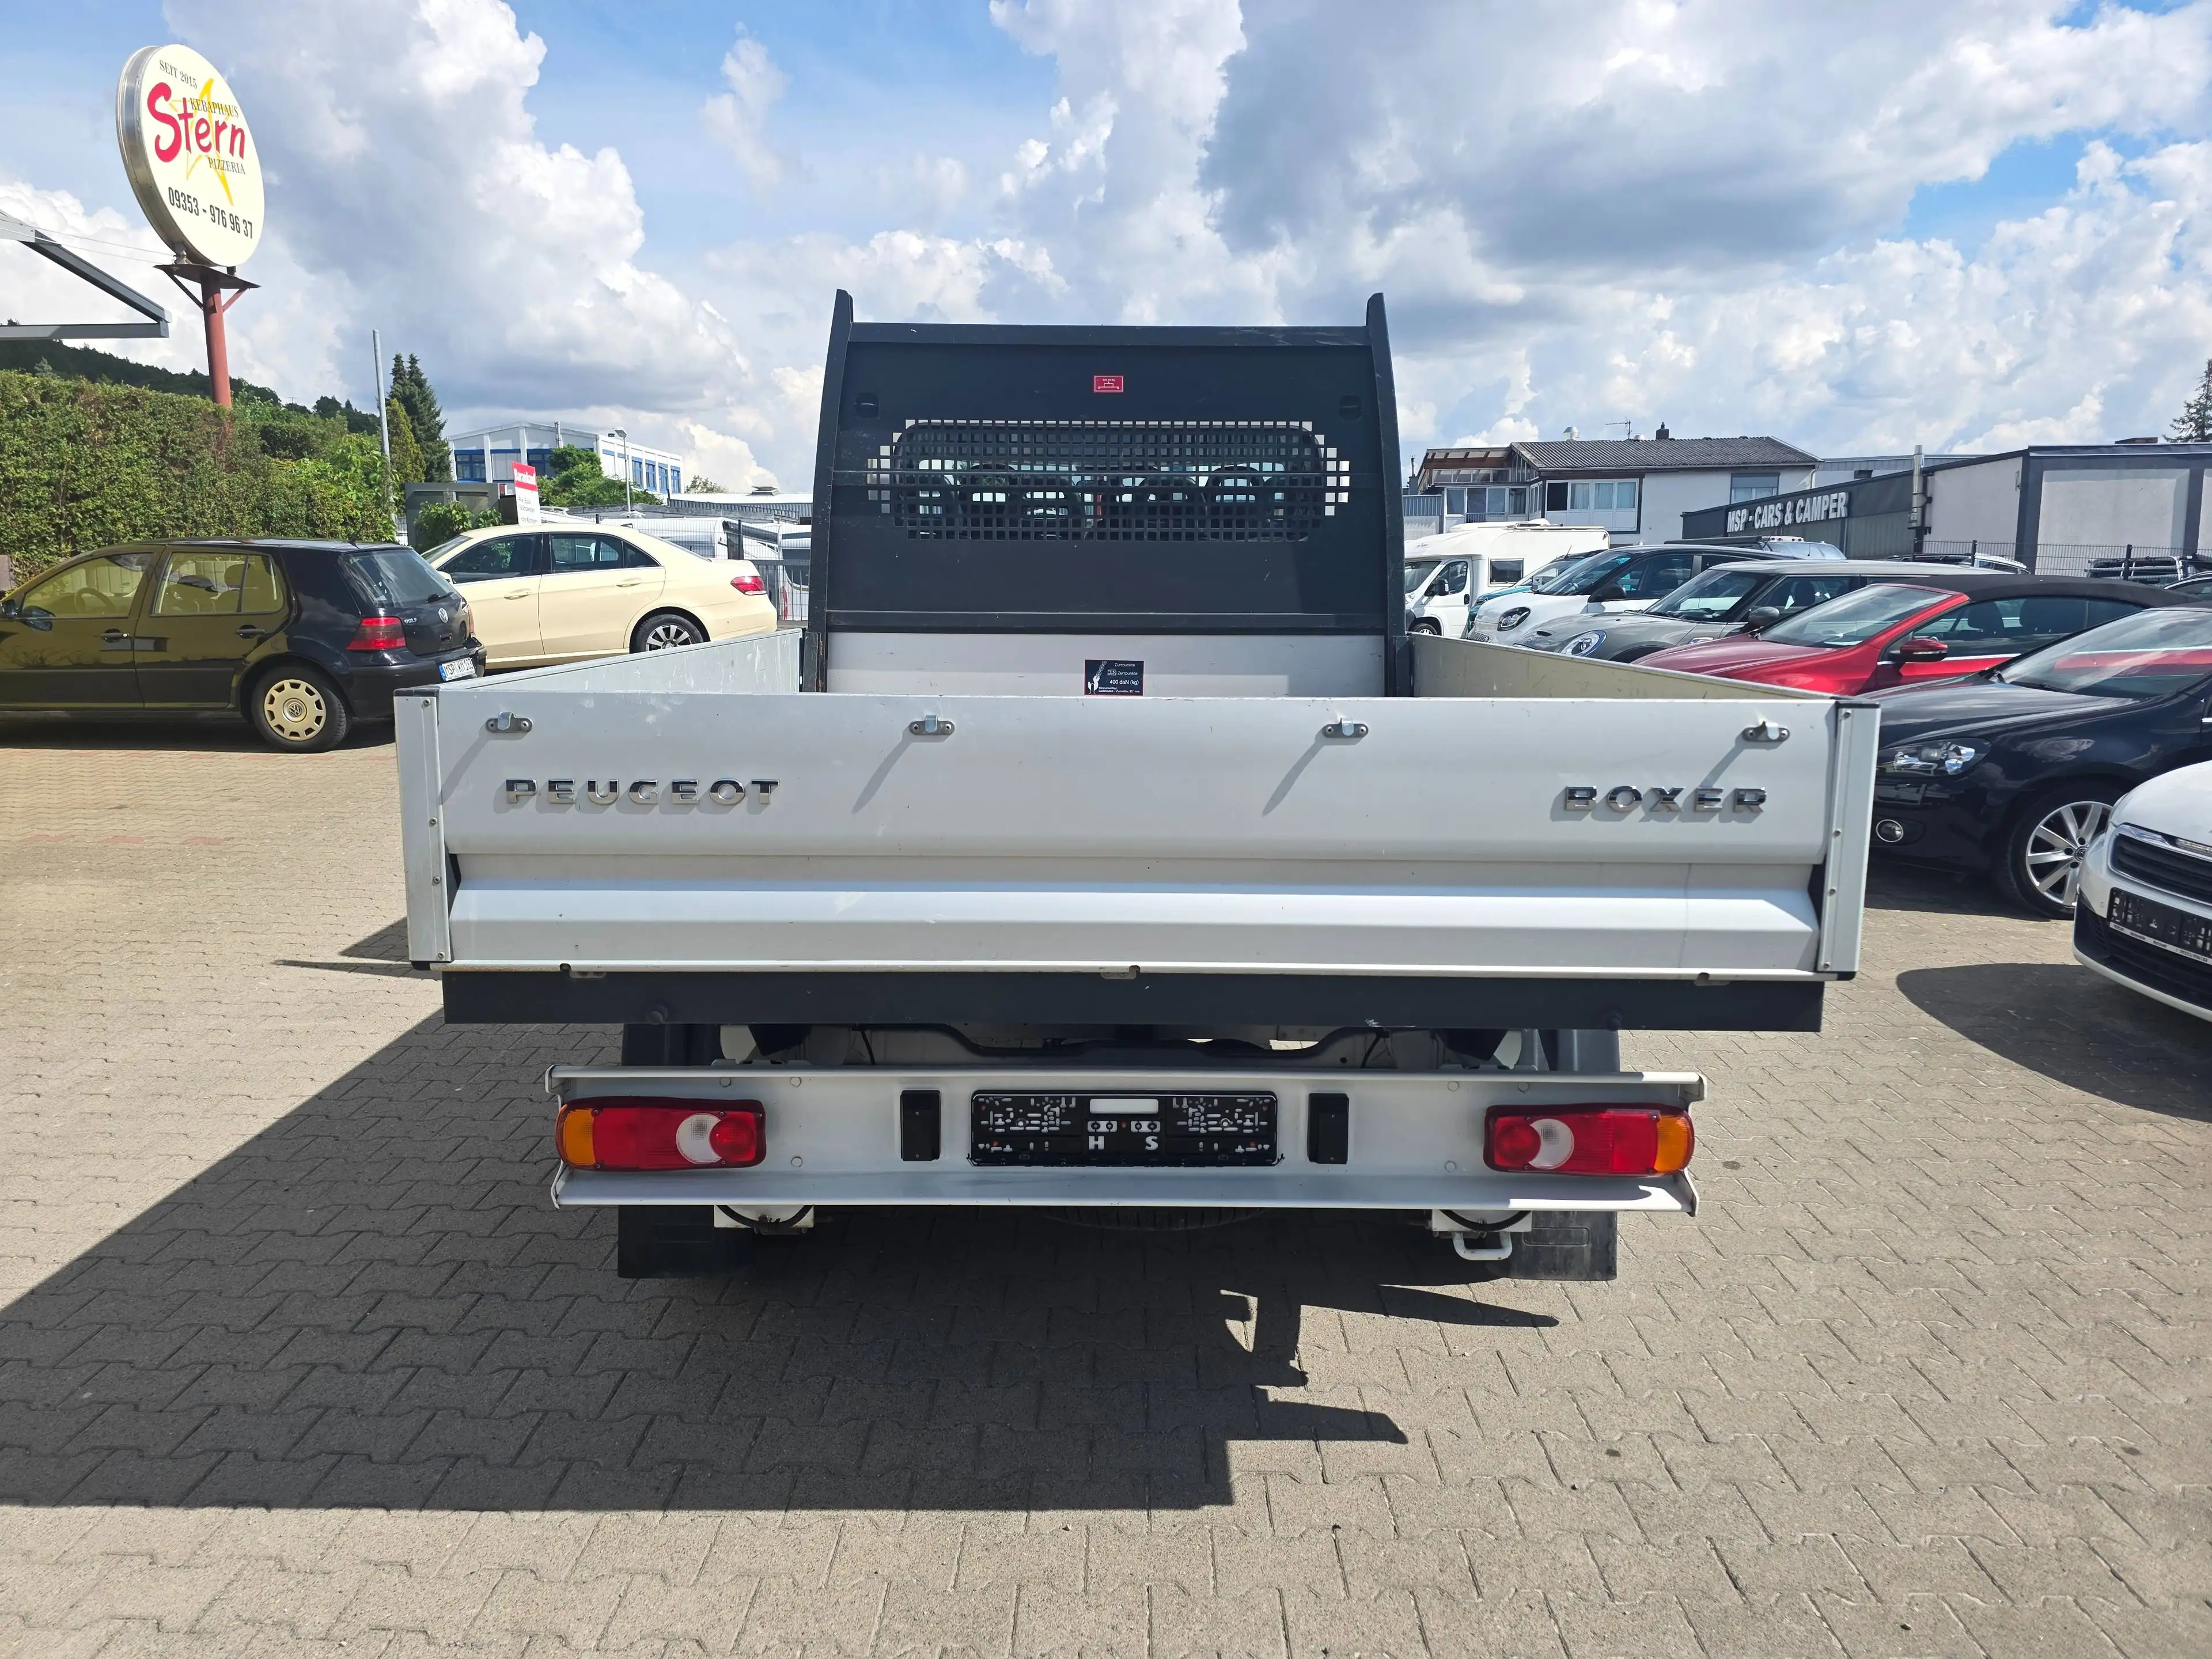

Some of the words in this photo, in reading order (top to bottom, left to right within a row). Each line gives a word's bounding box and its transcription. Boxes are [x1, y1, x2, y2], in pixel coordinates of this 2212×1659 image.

[159, 59, 178, 78] SEIT
[180, 70, 198, 89] 2015
[147, 82, 245, 162] Stern
[190, 97, 238, 118] KEBAPHAUS
[207, 157, 245, 175] PIZZERIA
[168, 187, 199, 216] 09353
[210, 204, 227, 228] 976
[230, 213, 240, 233] 96
[243, 220, 253, 239] 37
[1754, 502, 1783, 529] CARS
[1784, 501, 1794, 525] &
[1796, 492, 1849, 524] CAMPER
[506, 778, 780, 805] PEUGEOT
[1565, 785, 1768, 813] BOXER
